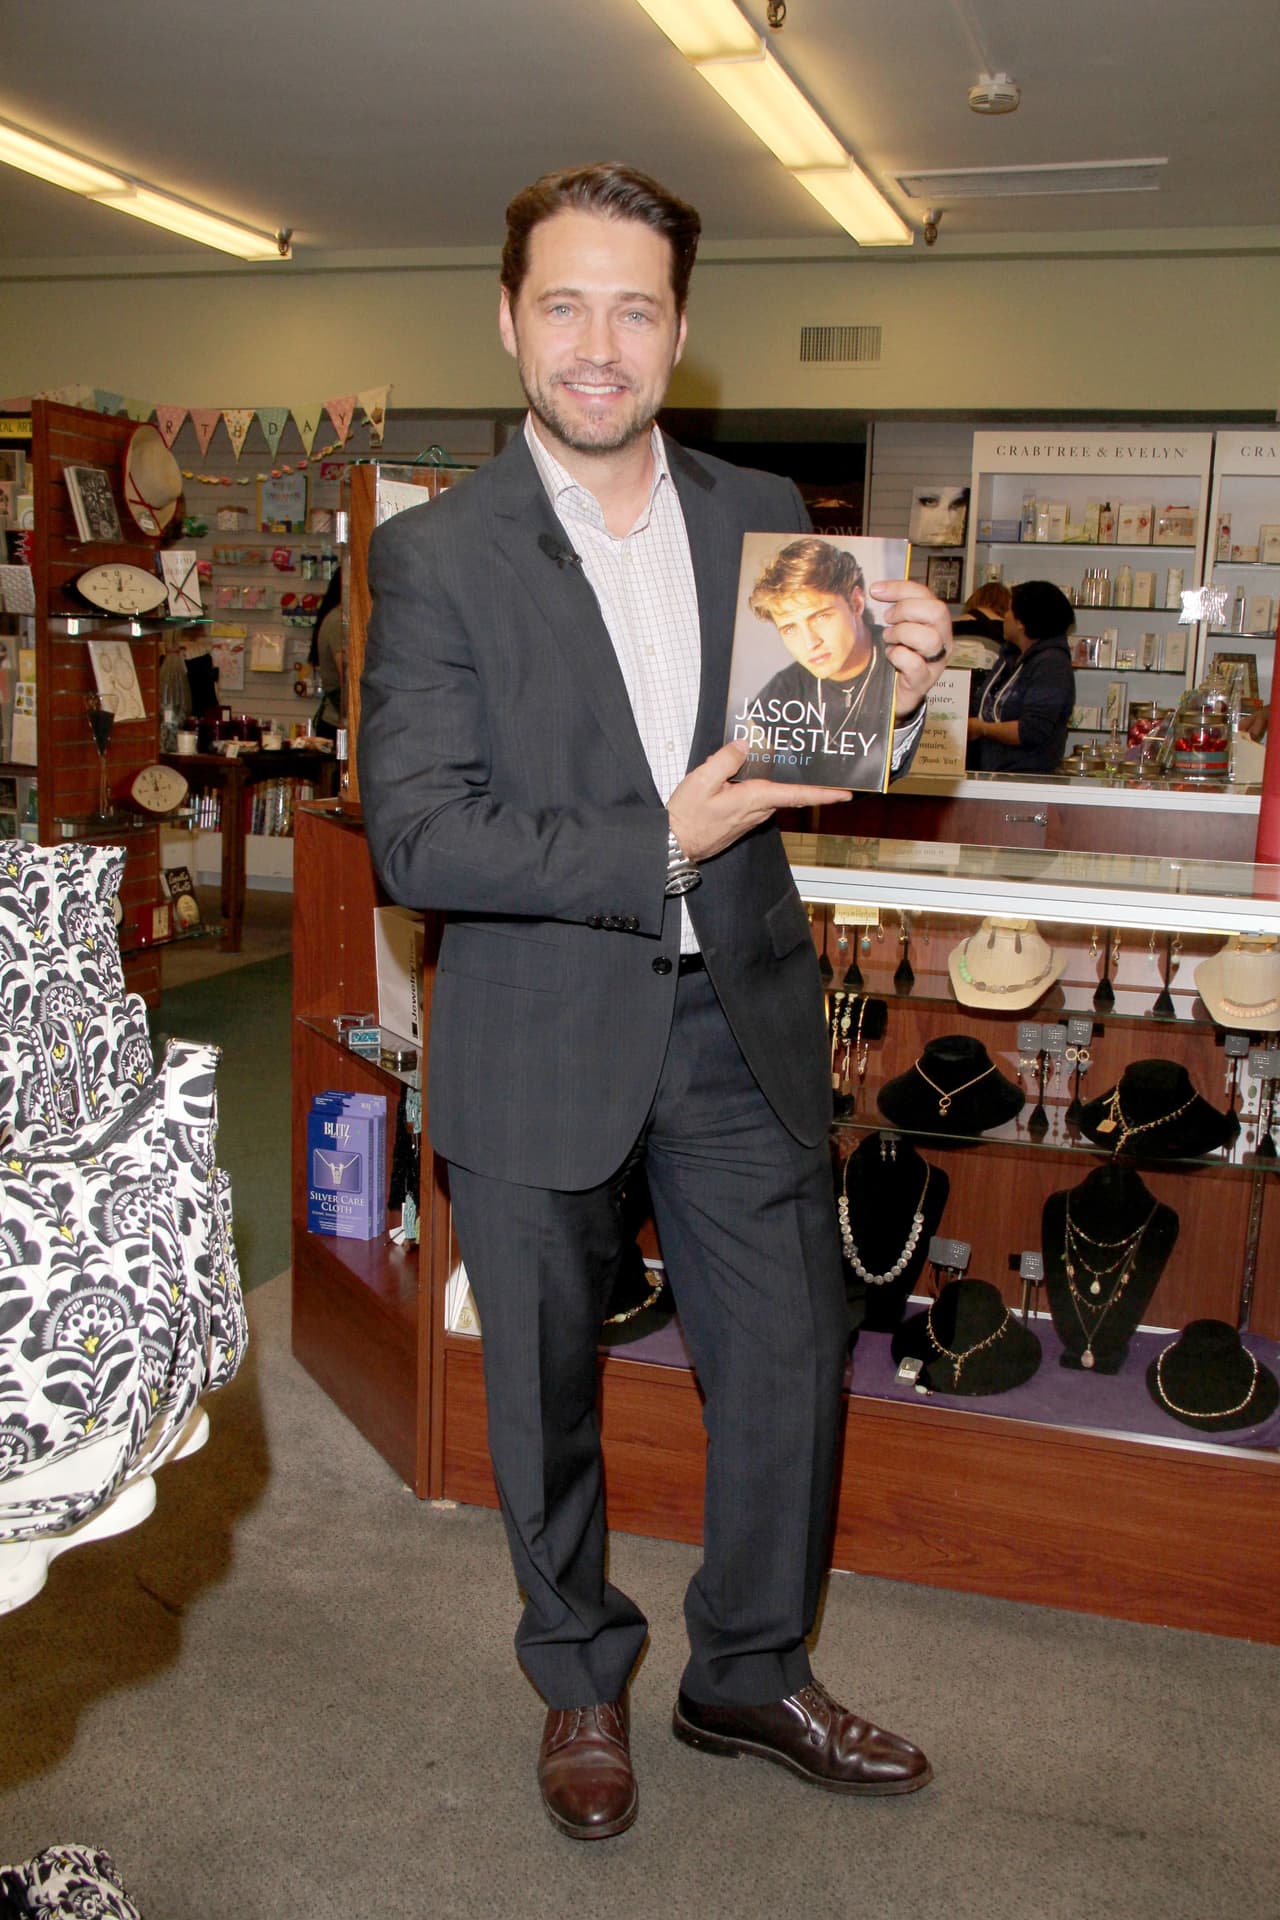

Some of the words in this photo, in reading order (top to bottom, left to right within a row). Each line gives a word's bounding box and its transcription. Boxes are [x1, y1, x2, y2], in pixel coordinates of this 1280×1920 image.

[996, 444, 1091, 458] CRABTREE
[1097, 446, 1109, 458] &
[1241, 446, 1276, 458] CRA
[735, 697, 827, 726] JASON
[733, 724, 878, 757] PRIESTLEY
[747, 751, 813, 766] memoir
[310, 1190, 339, 1204] SILVER
[340, 1194, 366, 1207] CARE
[321, 1202, 353, 1215] CLOTH
